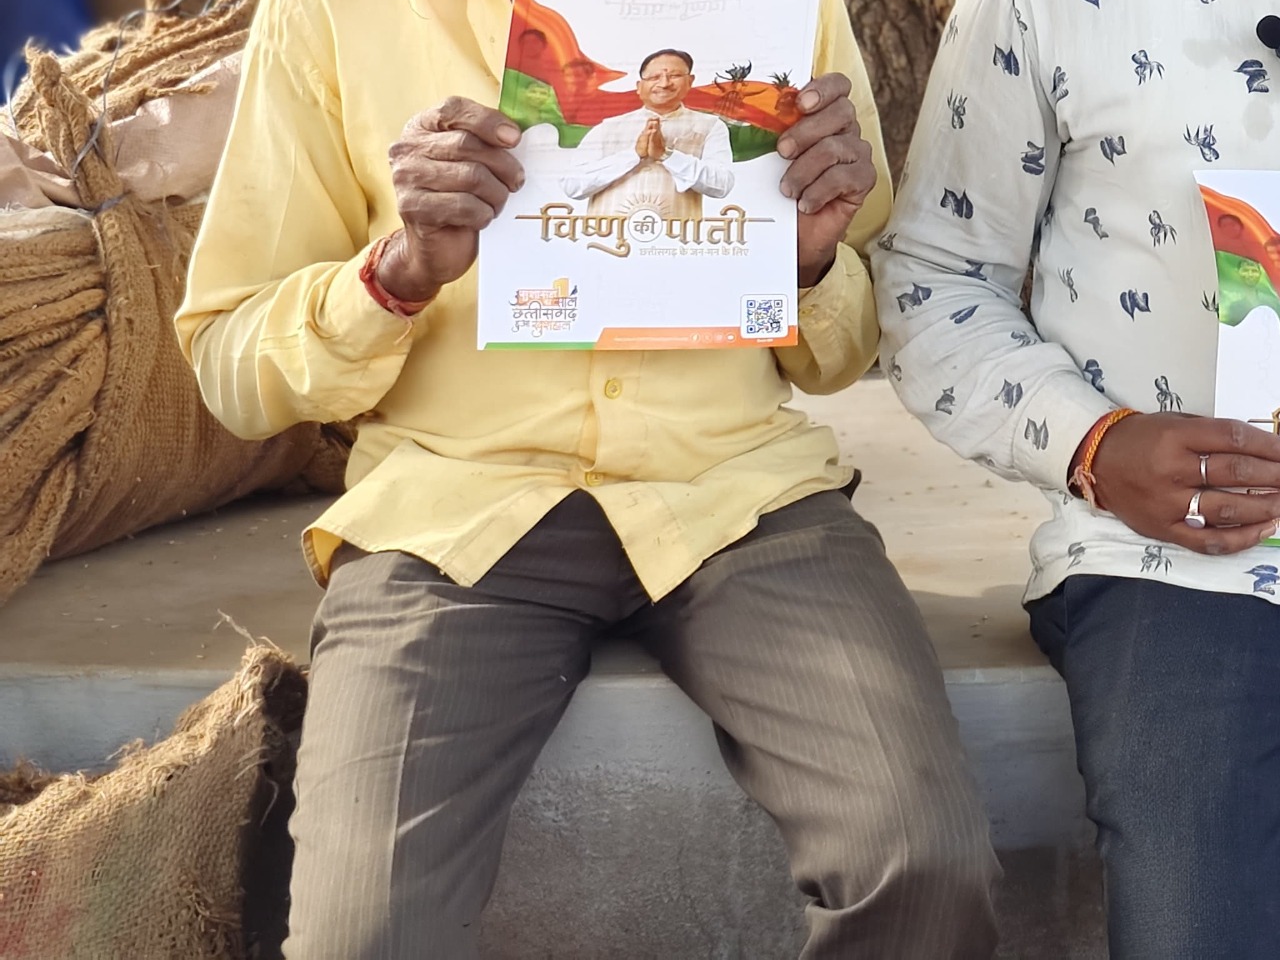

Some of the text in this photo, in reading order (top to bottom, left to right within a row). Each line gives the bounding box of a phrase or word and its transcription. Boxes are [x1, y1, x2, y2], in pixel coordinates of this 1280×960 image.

[540, 203, 748, 257] विष्णु की पाती
[732, 246, 749, 256] लिए
[512, 301, 578, 321] छत्तीसगढ़
